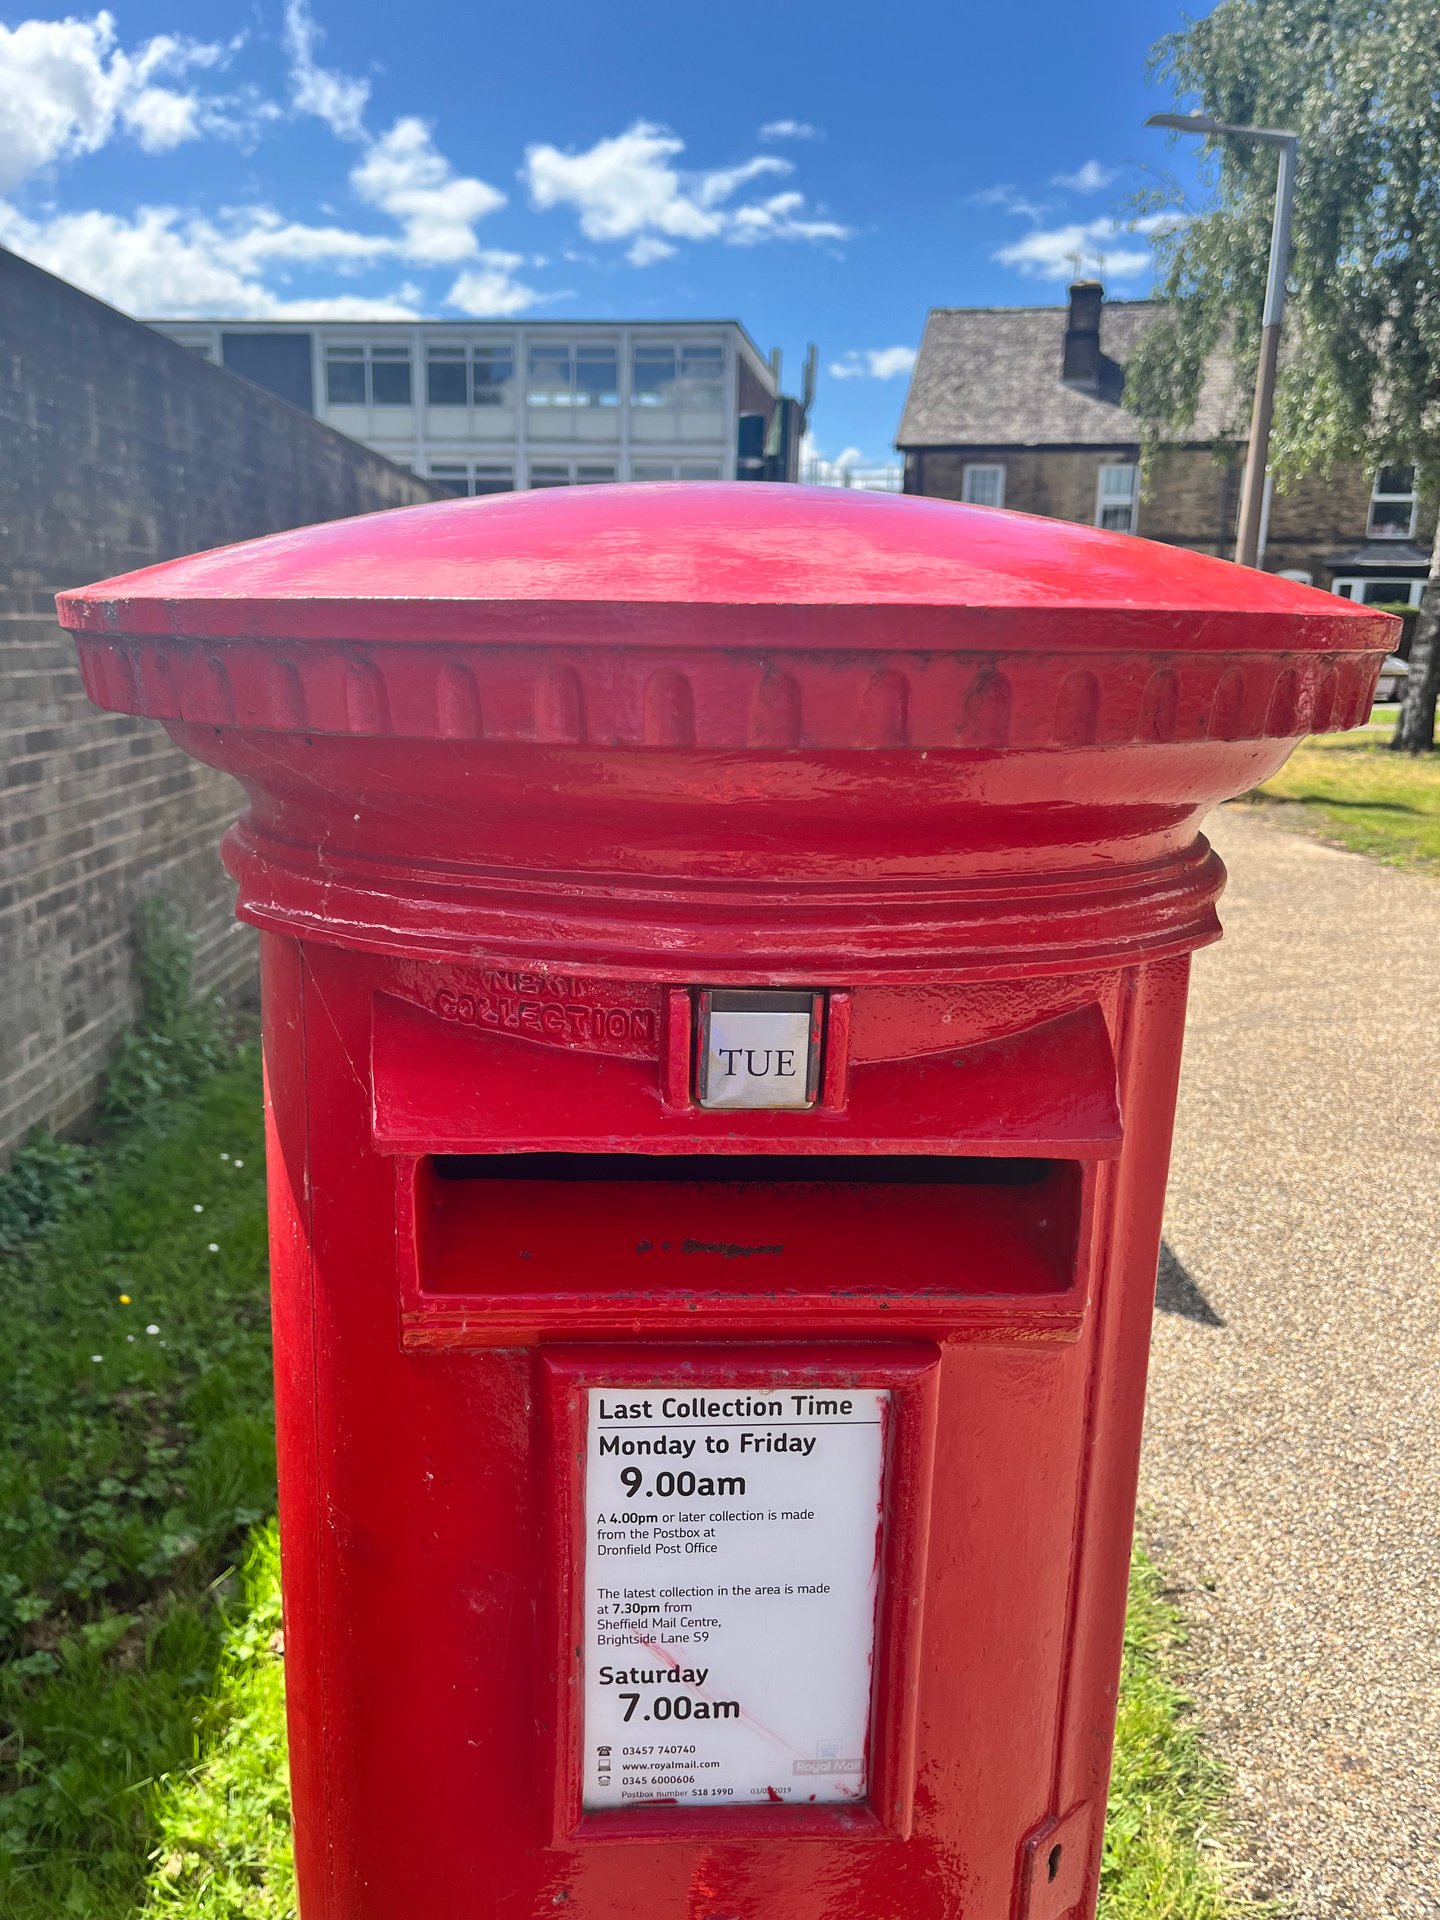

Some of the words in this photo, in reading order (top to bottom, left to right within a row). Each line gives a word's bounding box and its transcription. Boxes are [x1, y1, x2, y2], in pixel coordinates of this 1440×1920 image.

[436, 987, 656, 1041] COLLECTION
[719, 1048, 796, 1077] TUE
[599, 1399, 652, 1419] Last
[662, 1397, 783, 1418] Collection
[791, 1395, 852, 1415] Time
[600, 1435, 696, 1458] Monday
[705, 1436, 729, 1453] to
[741, 1433, 816, 1456] Friday
[620, 1466, 746, 1497] 9.00am
[597, 1514, 606, 1524] A
[609, 1513, 658, 1526] 4.00pm
[662, 1513, 675, 1523] or
[678, 1512, 706, 1522] later
[709, 1511, 764, 1522] collection
[768, 1510, 777, 1521] is
[781, 1509, 814, 1520] made
[597, 1529, 626, 1540] from
[630, 1529, 649, 1539] the
[654, 1528, 700, 1539] Postbox
[703, 1528, 715, 1538] at
[598, 1544, 650, 1556] Dronfield
[656, 1544, 681, 1554] Post
[685, 1542, 717, 1553] Office
[597, 1588, 620, 1599] The
[624, 1587, 656, 1598] latest
[659, 1586, 713, 1597] collection
[717, 1586, 728, 1596] in
[732, 1585, 751, 1596] the
[755, 1586, 780, 1595] area
[784, 1584, 793, 1594] is
[797, 1583, 830, 1594] made
[597, 1605, 609, 1614] at
[612, 1603, 660, 1615] 7.30pm
[664, 1602, 692, 1612] from
[597, 1618, 648, 1629] Sheffield
[652, 1618, 676, 1628] Mail
[680, 1617, 721, 1628] Centre,
[598, 1634, 657, 1647] Brightside
[661, 1633, 689, 1644] Lane
[693, 1632, 709, 1643] S9
[599, 1665, 709, 1686] Saturday
[618, 1694, 740, 1721] 7.00am
[622, 1746, 654, 1755] 03457
[658, 1745, 696, 1754] 740740
[622, 1760, 720, 1771] www.royalmail.com
[796, 1762, 831, 1773] Royal
[834, 1760, 861, 1771] Mail
[622, 1776, 648, 1785] 0345
[651, 1775, 695, 1784] 6000606
[622, 1790, 654, 1798] Postbox
[657, 1789, 687, 1797] number
